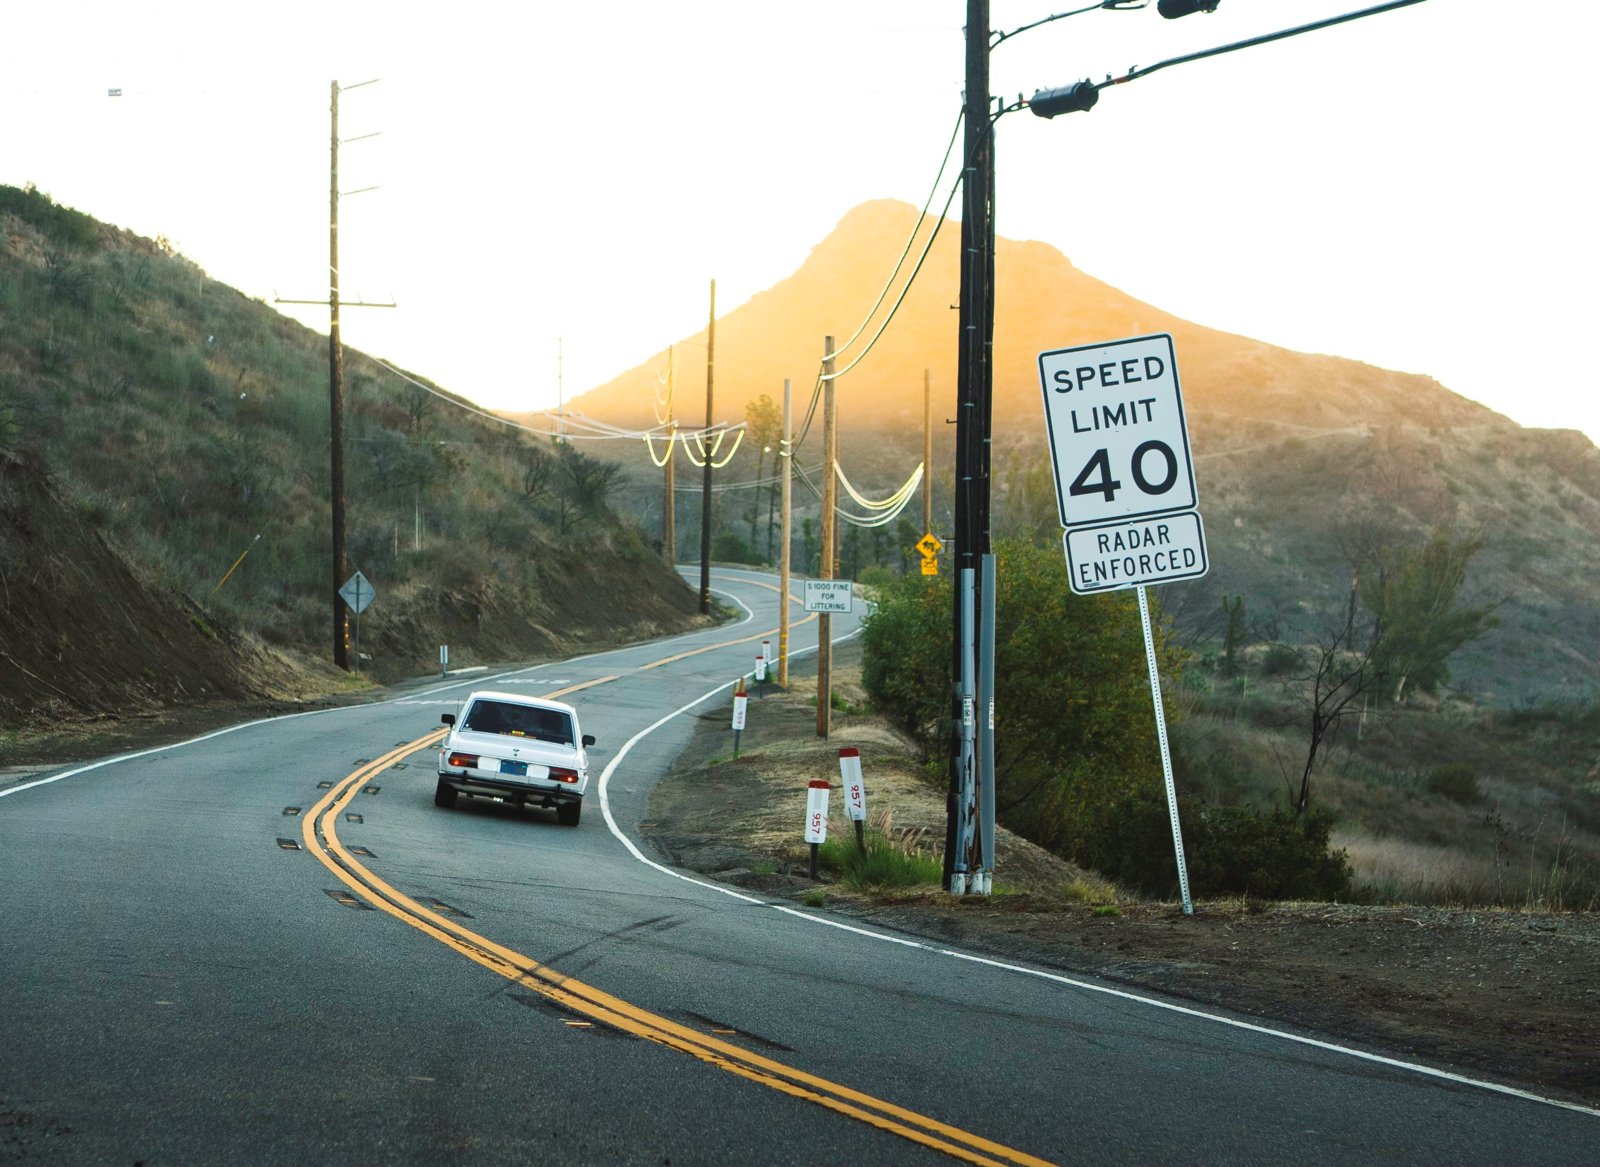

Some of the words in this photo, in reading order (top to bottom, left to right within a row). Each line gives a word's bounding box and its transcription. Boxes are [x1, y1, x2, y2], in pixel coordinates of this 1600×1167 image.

[1053, 356, 1165, 393] SPEED
[1071, 397, 1157, 433] LIMIT
[1069, 439, 1178, 502] 40
[1097, 524, 1171, 554] RADAR
[1079, 547, 1196, 584] ENFORCED
[833, 583, 849, 591] FINE
[810, 602, 845, 610] LITTERING
